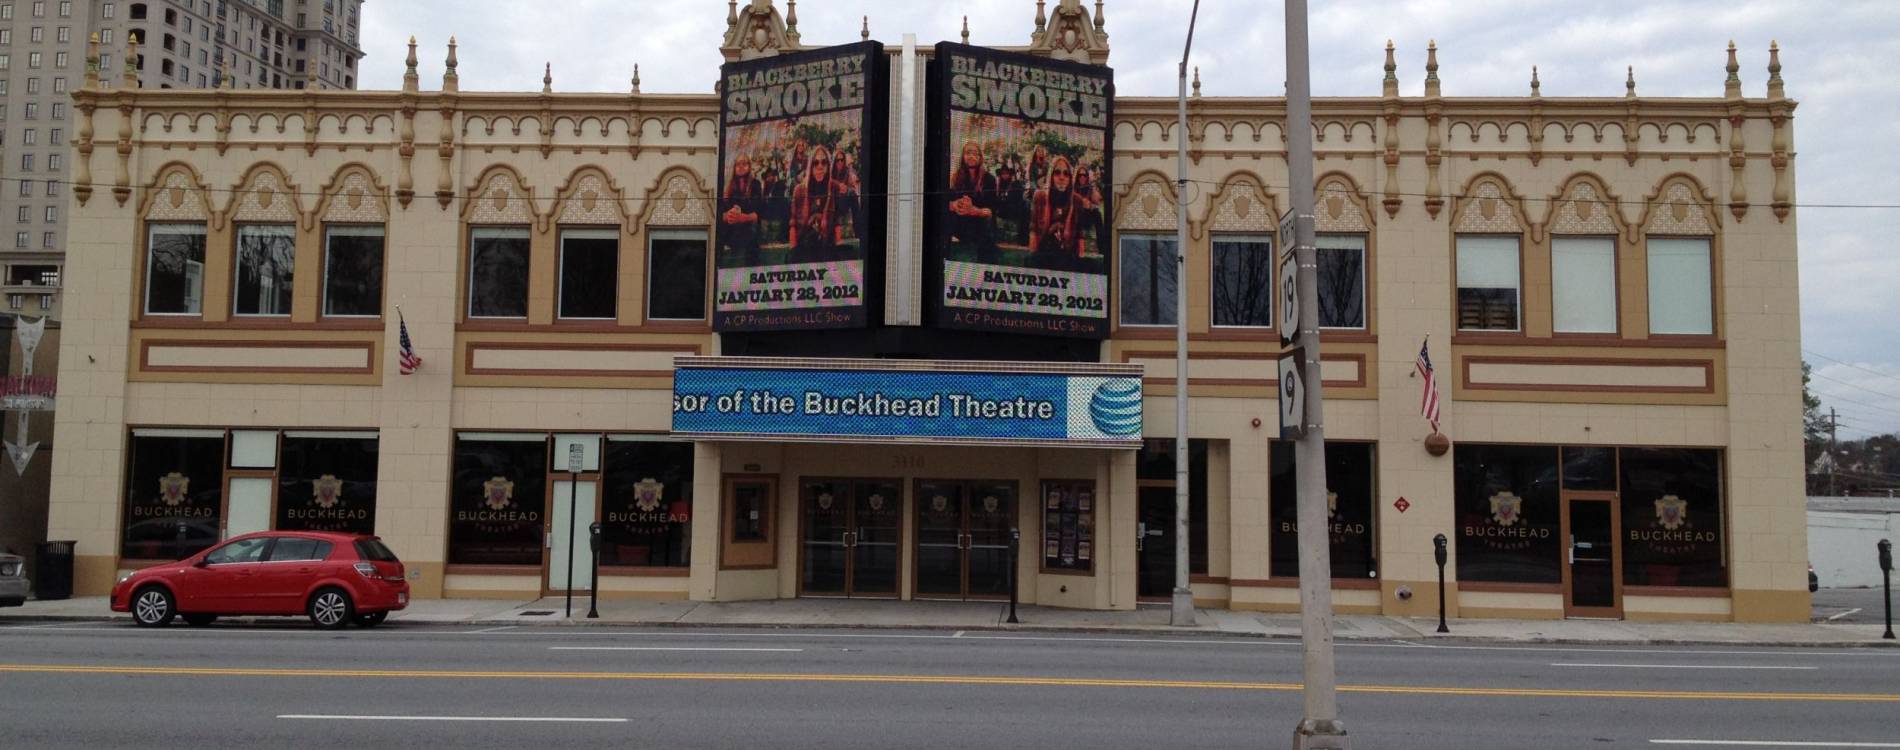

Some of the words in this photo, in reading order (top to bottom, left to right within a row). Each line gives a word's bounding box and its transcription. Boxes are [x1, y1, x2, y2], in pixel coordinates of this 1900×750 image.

[727, 54, 866, 91] BLACKBERRY
[951, 55, 1107, 96] BLACKBERRY
[726, 73, 865, 123] SMOKE
[951, 74, 1107, 128] SMOKE
[750, 268, 828, 284] SATURDAY
[984, 271, 1070, 289] SATURDAY
[719, 288, 795, 304] JANUARY
[796, 287, 820, 303] 28,
[822, 285, 859, 299] 2012
[946, 286, 1037, 306] JANUARY
[1038, 294, 1063, 311] 28,
[1066, 296, 1103, 311] 2012
[1283, 275, 1294, 324] 19
[724, 316, 730, 326] A
[733, 315, 746, 326] CP
[748, 314, 801, 326] Productions
[804, 313, 821, 324] LLC
[825, 312, 850, 322] Show
[954, 312, 962, 322] A
[965, 313, 980, 324] CP
[984, 314, 1044, 329] Productions
[1047, 319, 1064, 331] LLC
[1070, 321, 1096, 332] Show
[1285, 370, 1295, 415] 9
[717, 391, 745, 413] of
[749, 390, 795, 414] the
[804, 392, 941, 418] Buckhead
[948, 394, 1054, 419] Theatre
[134, 505, 214, 518] BUCKHEAD
[287, 508, 367, 520] BUCKHEAD
[458, 511, 538, 521] BUCKHEAD
[608, 512, 689, 523] BUCKHEAD
[1465, 526, 1550, 538] BUCKHEAD
[1631, 530, 1716, 542] BUCKHEAD
